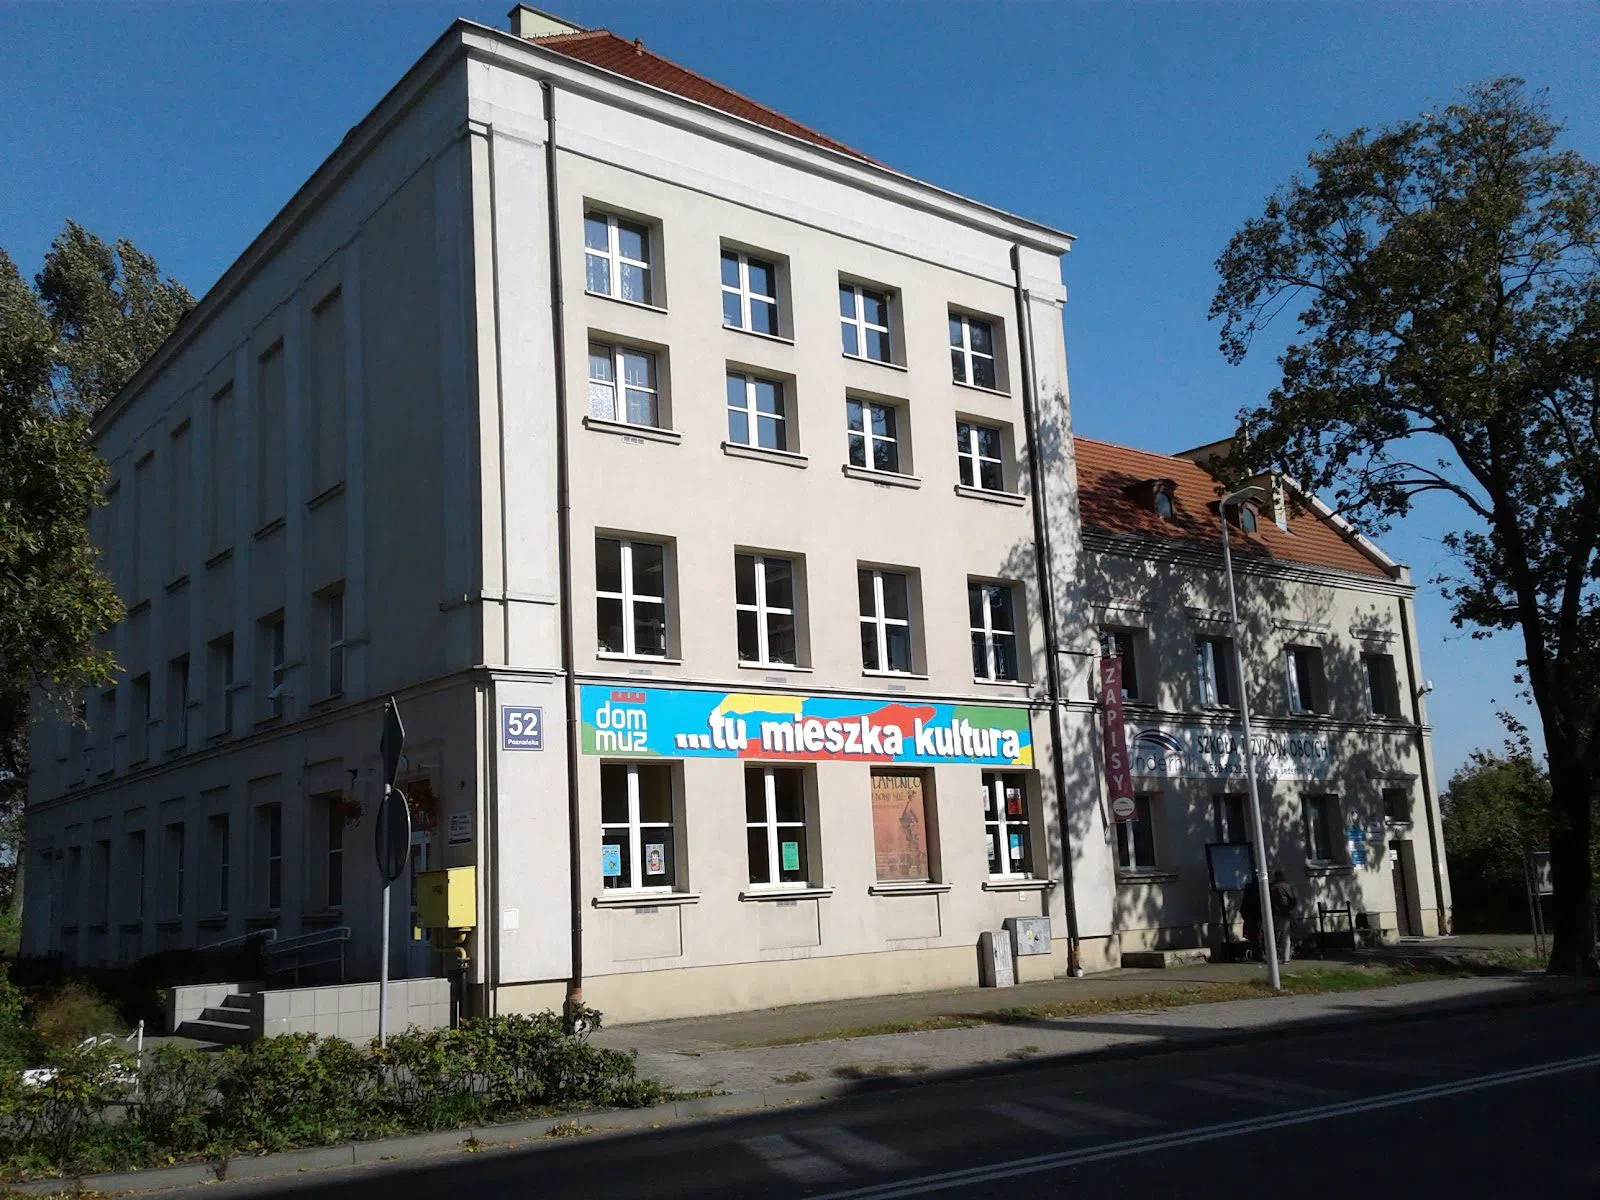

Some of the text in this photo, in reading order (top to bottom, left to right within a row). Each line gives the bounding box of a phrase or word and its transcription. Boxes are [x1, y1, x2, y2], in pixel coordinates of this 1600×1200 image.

[508, 712, 538, 736] 52
[596, 701, 648, 729] dom
[595, 730, 648, 752] muz
[761, 712, 904, 755] mieszka
[914, 717, 1020, 759] kultura
[1105, 668, 1124, 791] ZAPISY
[507, 738, 539, 746] Poznańska
[1197, 735, 1328, 759] SZKOŁA JZYKÓW OBCYCH
